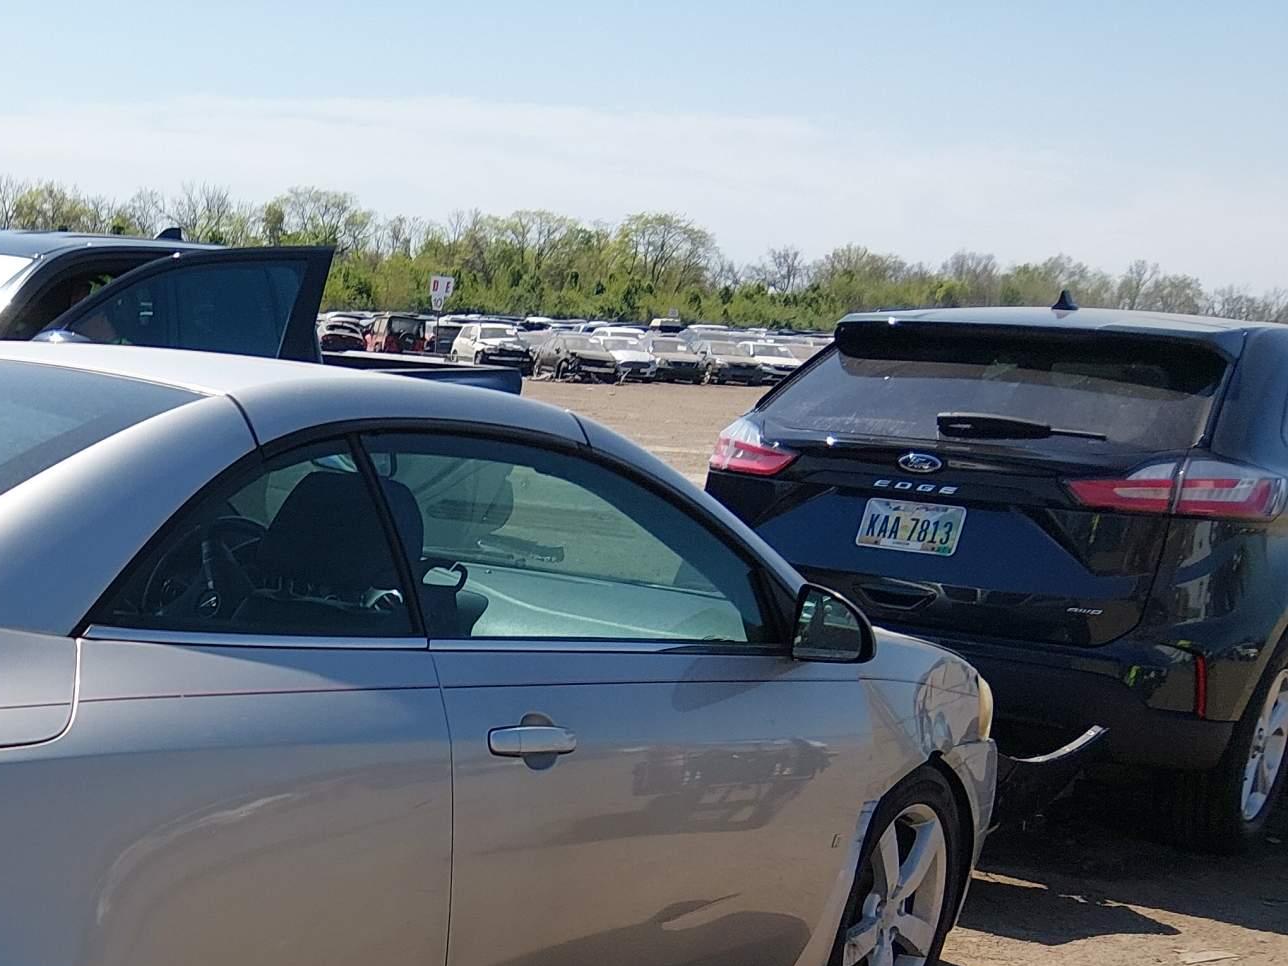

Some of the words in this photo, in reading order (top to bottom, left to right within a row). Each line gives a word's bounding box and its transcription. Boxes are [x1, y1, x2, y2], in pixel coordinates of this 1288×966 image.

[873, 479, 959, 495] EDGE
[865, 513, 901, 540] KAA
[906, 517, 953, 545] 7813
